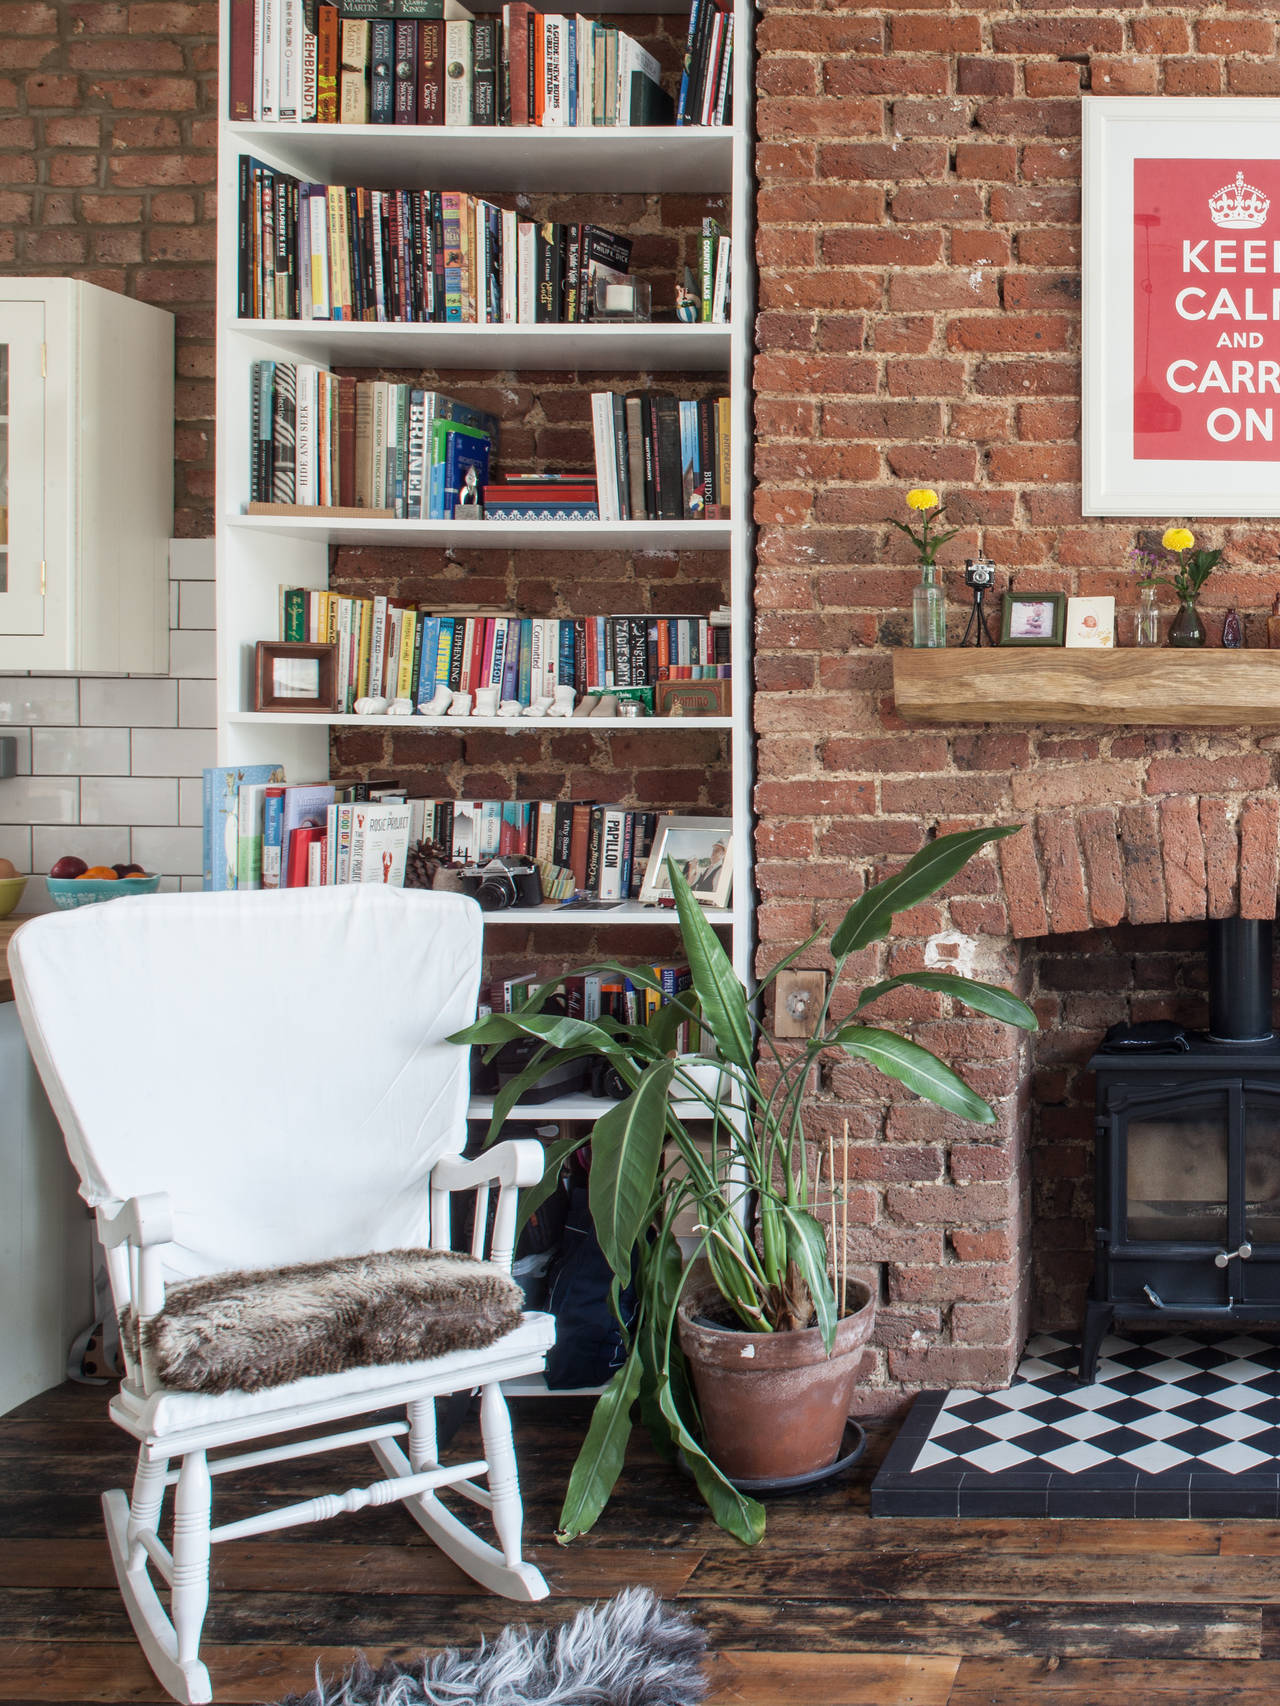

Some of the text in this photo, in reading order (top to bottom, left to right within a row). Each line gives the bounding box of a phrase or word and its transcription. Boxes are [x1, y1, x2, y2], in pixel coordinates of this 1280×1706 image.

[343, 3, 378, 12] MARTIN
[402, 5, 427, 13] KINGS
[347, 23, 356, 58] MARTIN
[375, 24, 385, 59] MARTIN
[399, 25, 408, 60] MARTIN
[424, 25, 433, 60] MARTIN
[450, 25, 458, 60] MARTIN
[476, 25, 484, 60] MARTIN
[546, 24, 553, 33] OF
[304, 34, 315, 109] REMBRANDT
[346, 81, 355, 113] THRONES
[376, 81, 385, 111] SWORDS
[399, 82, 408, 112] SWORDS
[424, 83, 433, 109] CROWS
[478, 82, 488, 114] DRAGONS
[279, 184, 287, 257] THE EXPLORER'S EYE
[570, 243, 579, 252] The
[593, 243, 629, 264] PHILIP DICK
[703, 239, 711, 300] COUNTRY WALKS
[540, 282, 549, 304] Gods
[1216, 332, 1264, 349] AND
[1206, 407, 1274, 442] ON
[300, 405, 309, 487] HIDE AND SEEK
[407, 404, 425, 505] BRUNEL
[375, 625, 383, 654] SUCKED
[451, 624, 465, 683] STEPHEN KING
[532, 624, 543, 670] Committed
[616, 625, 629, 655] ZADIE
[435, 636, 452, 680] INTERN
[492, 630, 505, 684] BILL BRYSON
[617, 655, 630, 687] SMITH
[633, 637, 646, 687] Night Cir
[672, 693, 709, 708] Domino
[268, 800, 278, 817] What
[487, 807, 496, 819] the
[267, 823, 278, 845] Expect
[340, 809, 351, 856] GOOD IDEAS
[369, 816, 409, 833] ROSIE PROJECT
[487, 819, 495, 834] dice
[590, 828, 600, 851] Game
[354, 839, 364, 858] ROSIE
[561, 820, 571, 861] Fifty Shades
[605, 820, 620, 869] PAPILLON
[623, 840, 631, 860] ADAMS
[351, 859, 364, 883] PROJECT
[588, 852, 600, 876] Crying
